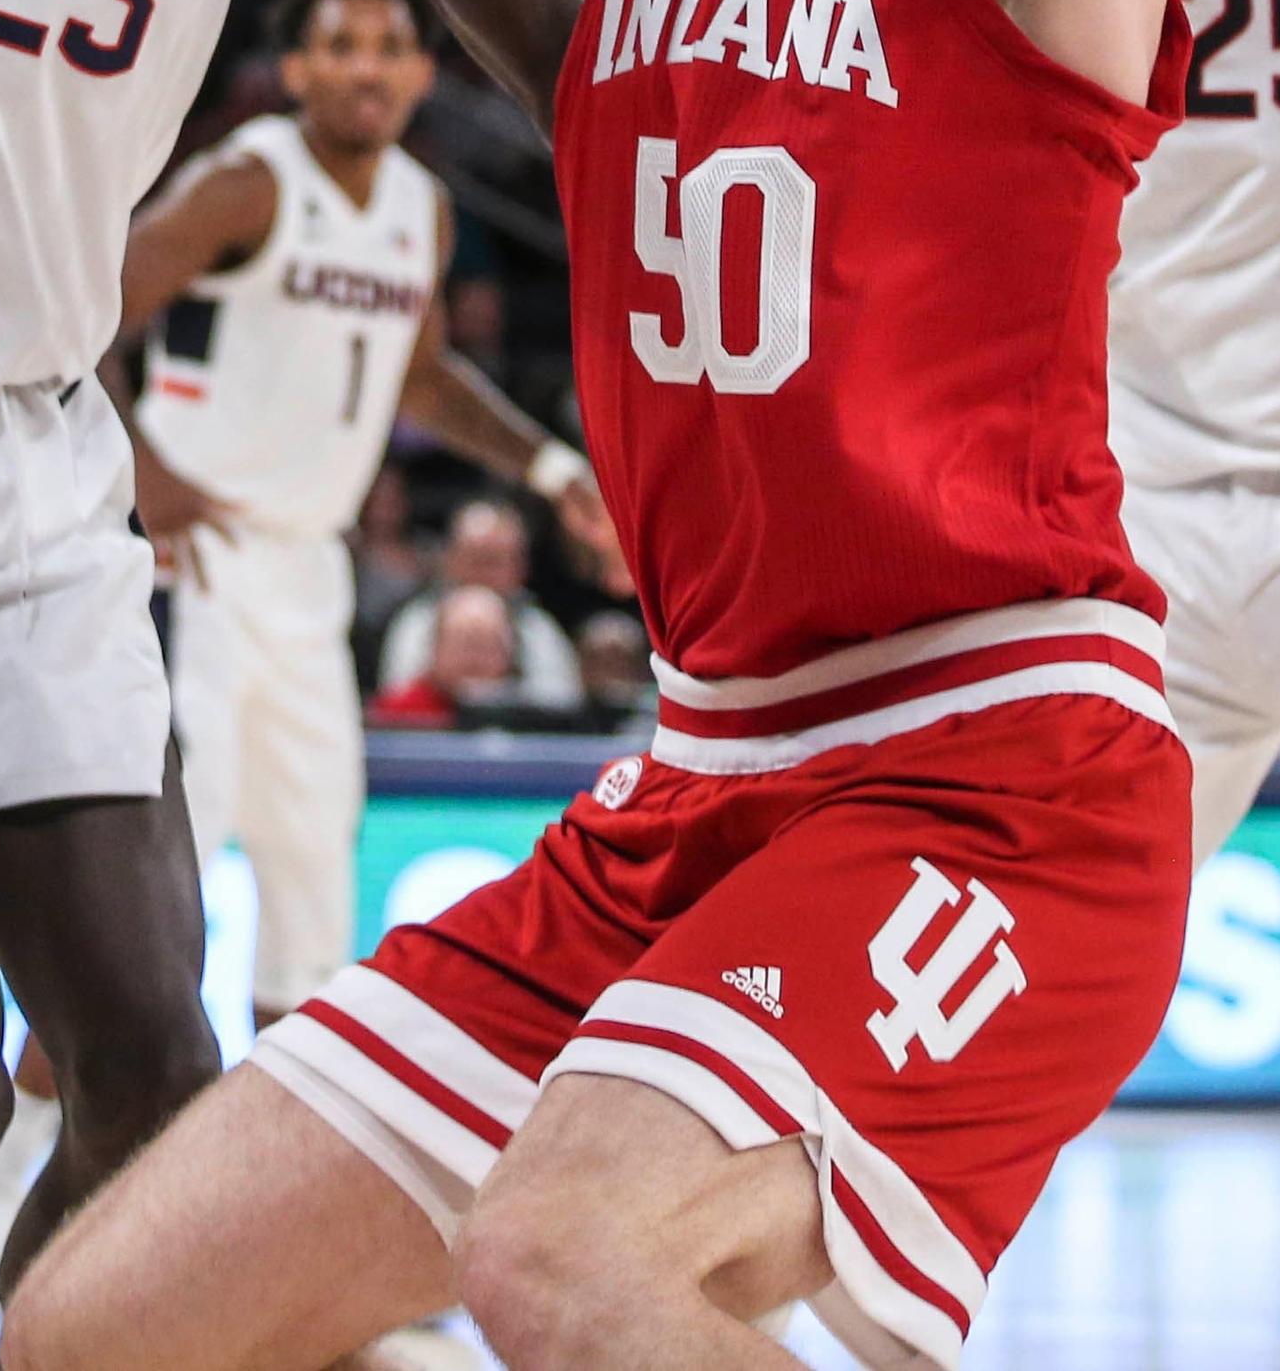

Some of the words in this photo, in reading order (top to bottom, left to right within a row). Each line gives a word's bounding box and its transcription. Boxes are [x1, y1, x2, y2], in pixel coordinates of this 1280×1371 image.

[628, 135, 817, 396] 50
[341, 332, 366, 425] 1
[721, 970, 785, 1019] adidas
